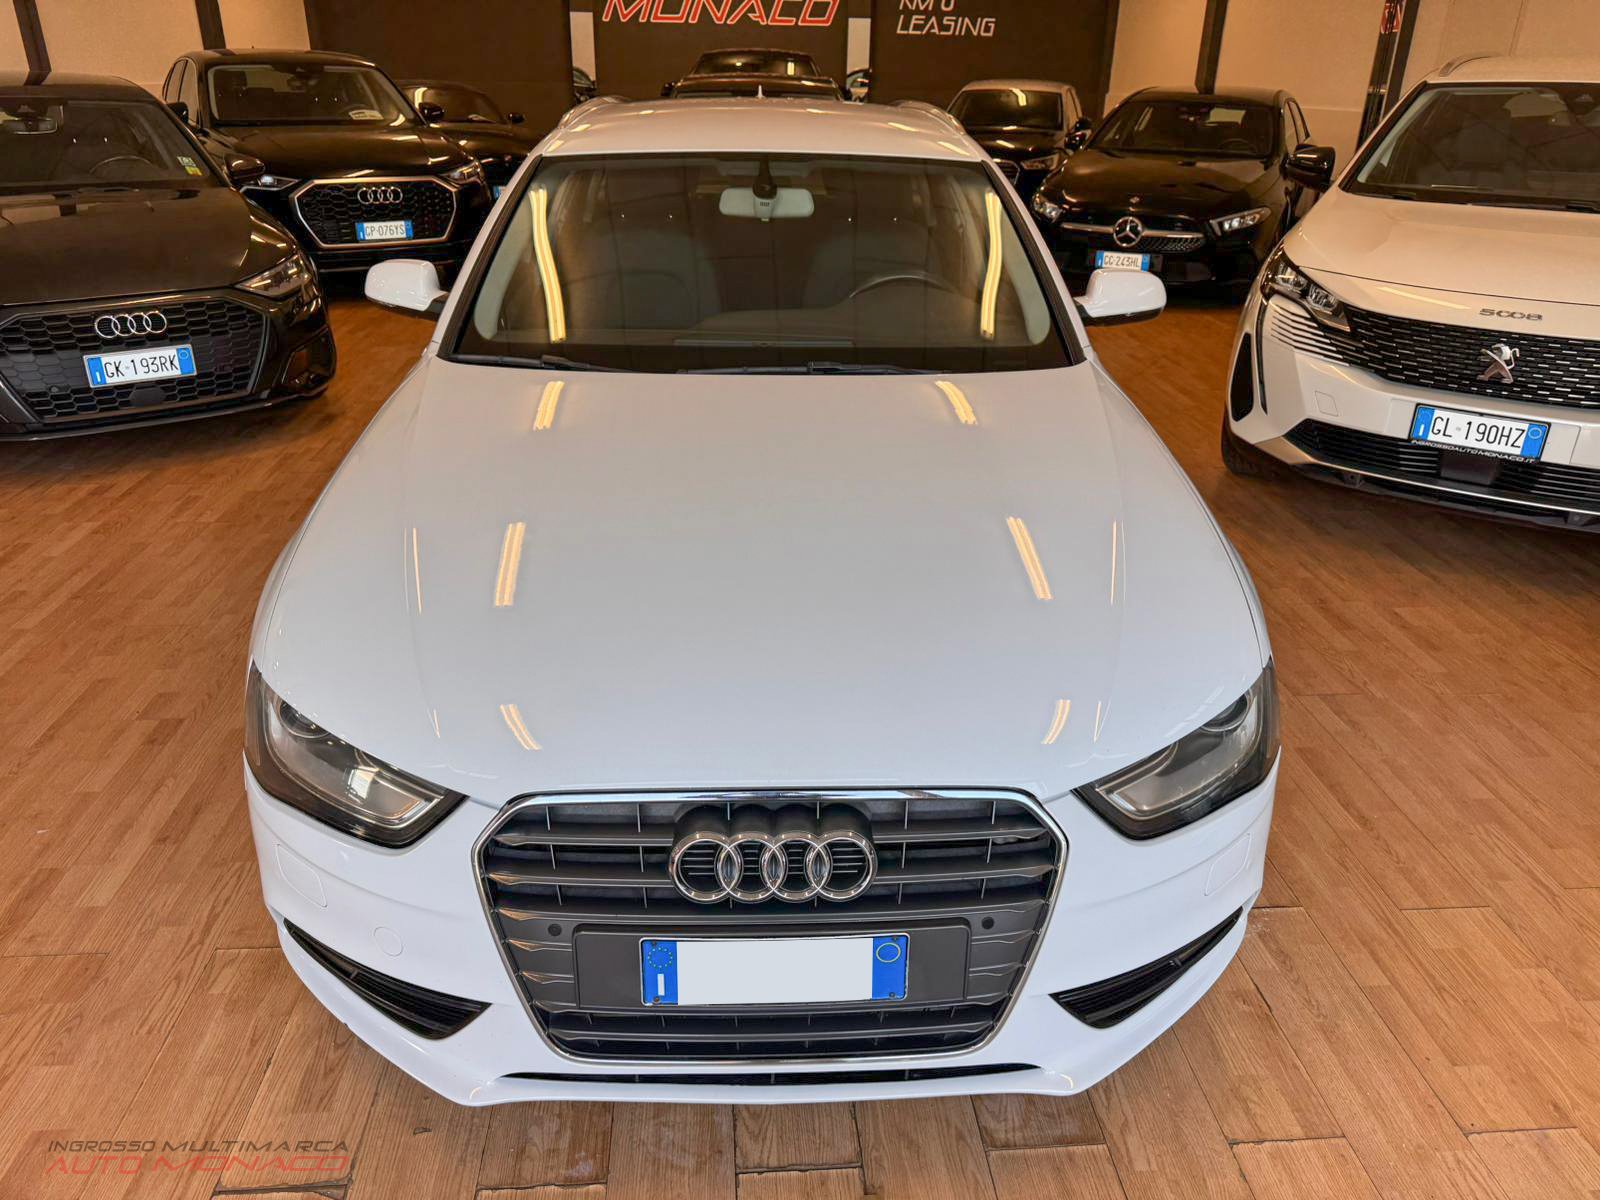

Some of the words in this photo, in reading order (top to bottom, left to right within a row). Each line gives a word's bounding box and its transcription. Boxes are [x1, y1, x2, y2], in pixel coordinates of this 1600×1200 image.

[602, 0, 839, 26] MONACO
[896, 15, 996, 37] LEASING
[1479, 308, 1543, 321] 5008
